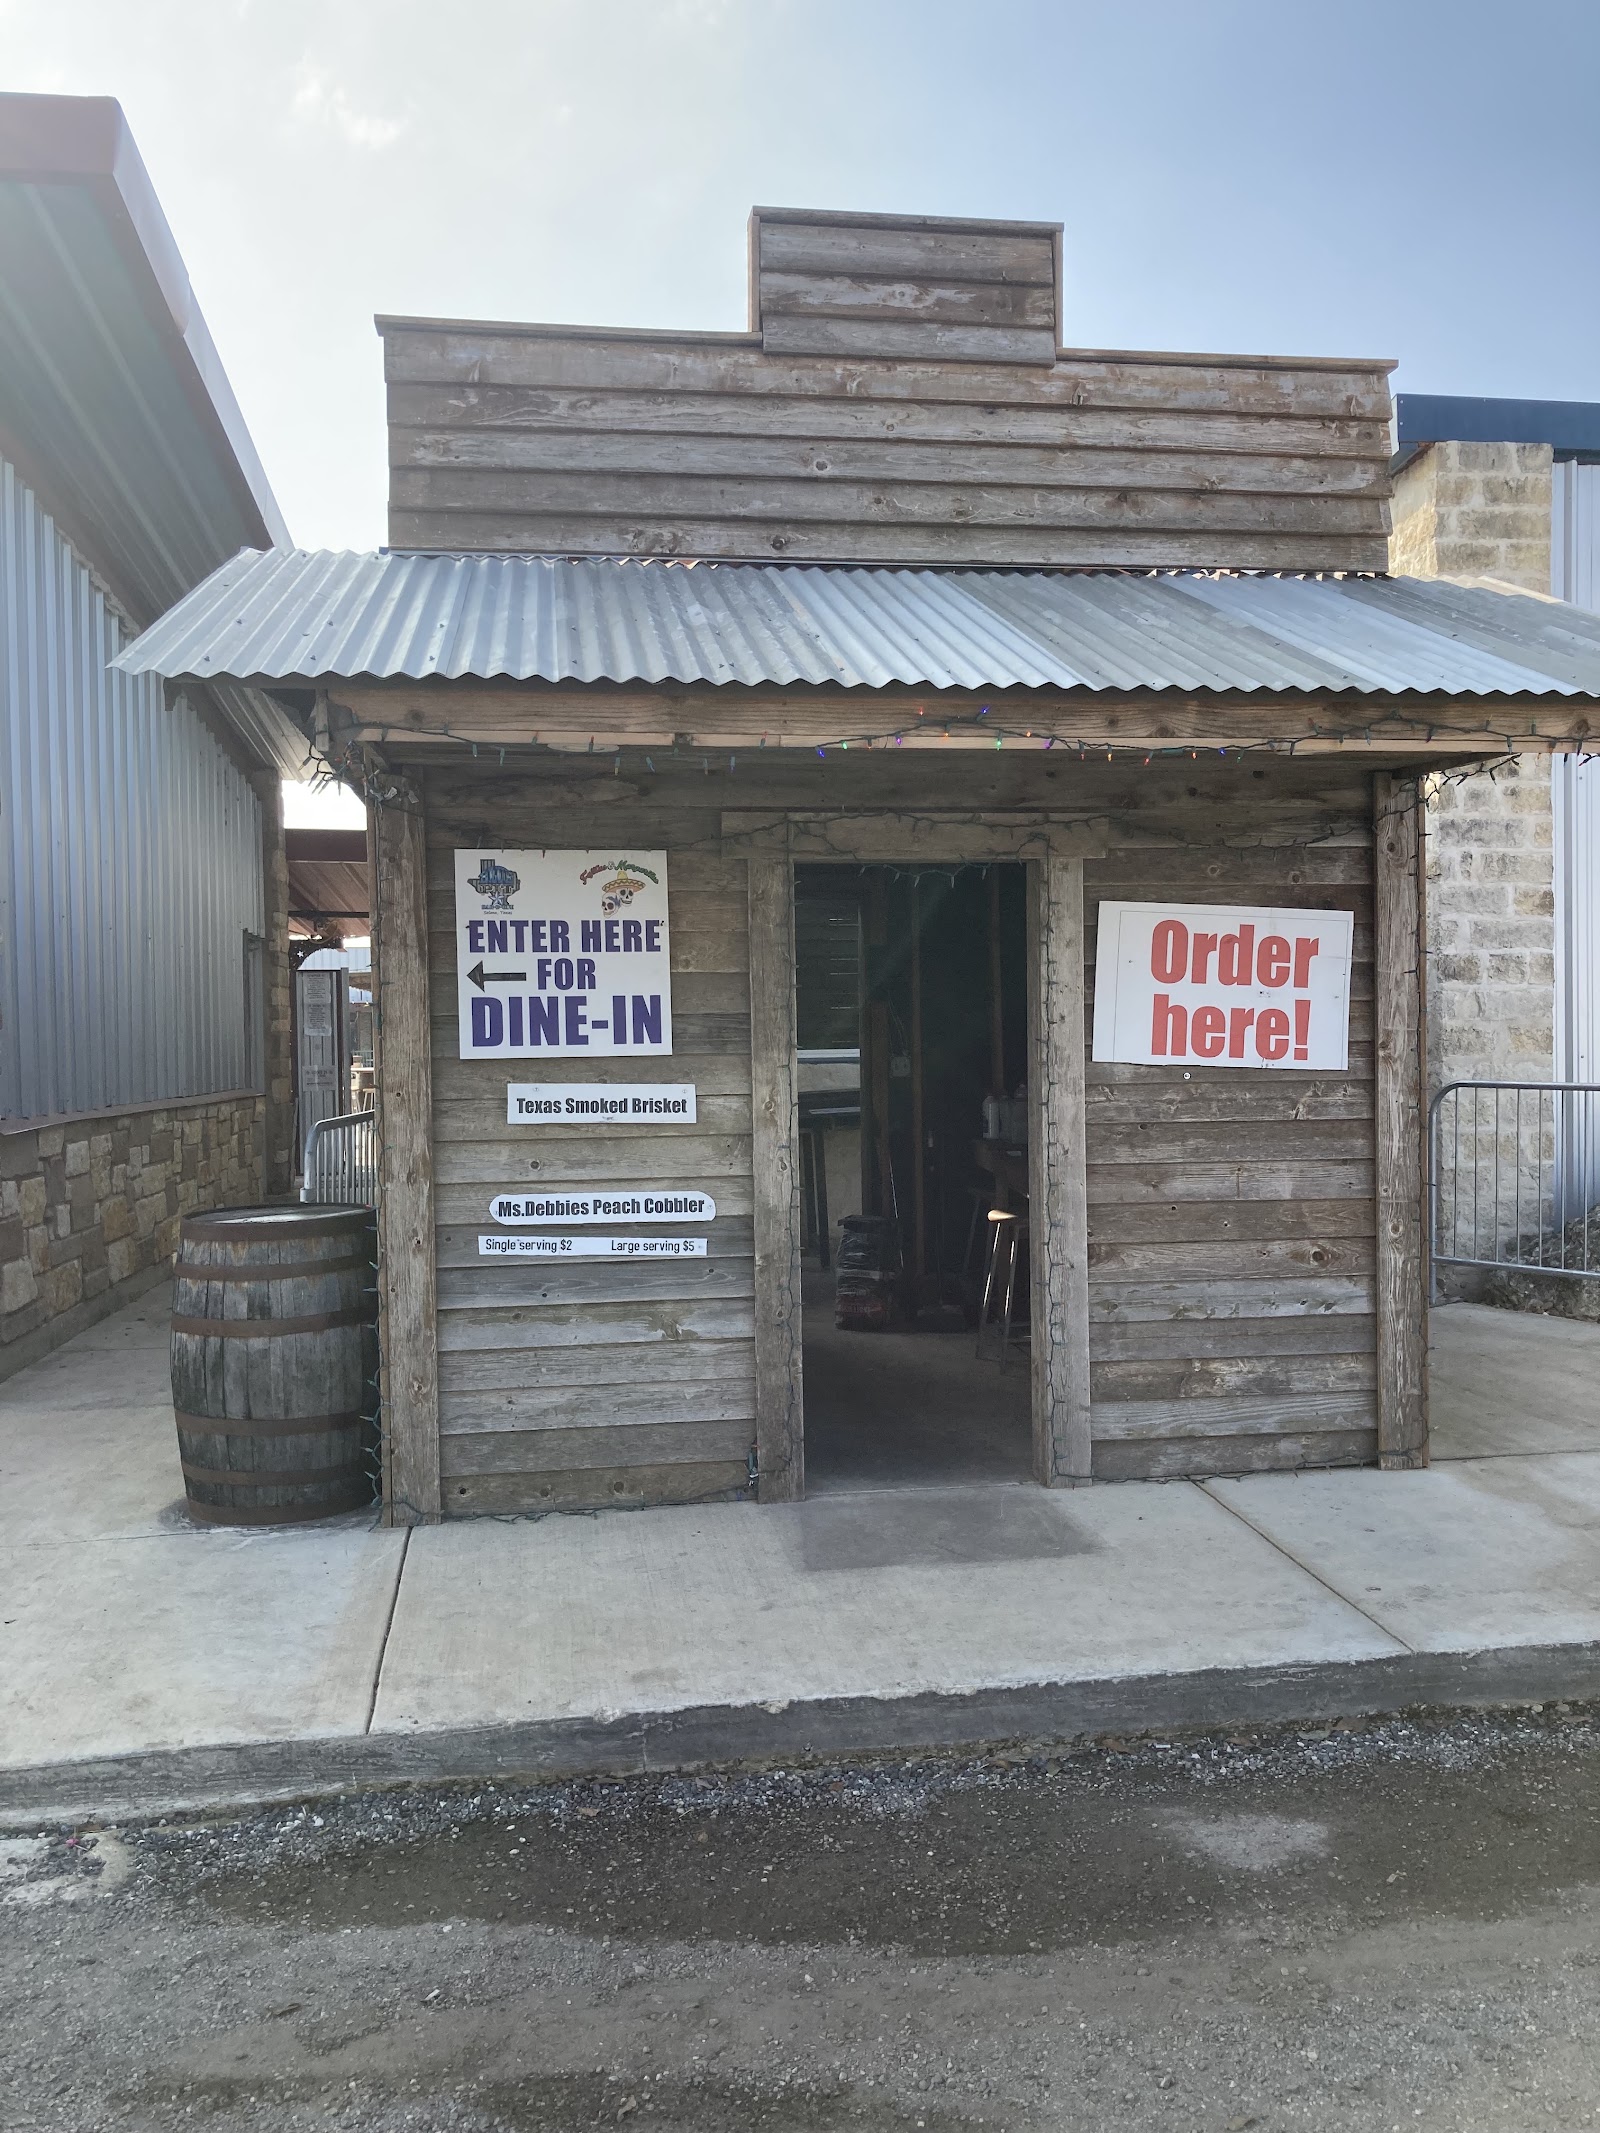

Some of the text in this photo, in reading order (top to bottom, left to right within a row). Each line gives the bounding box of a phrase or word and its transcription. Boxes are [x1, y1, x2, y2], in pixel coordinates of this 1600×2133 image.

[469, 920, 661, 953] ENTER HERE
[1150, 919, 1319, 988] Order
[537, 958, 596, 990] FOR
[471, 995, 662, 1047] DINE-IN
[1151, 993, 1311, 1061] here!
[517, 1097, 688, 1114] Texas Smoked Brisket
[498, 1197, 705, 1217] Ms.Debbies Peach Cobbler
[485, 1239, 573, 1252] Single serving $2
[611, 1240, 695, 1253] Large serving $5
